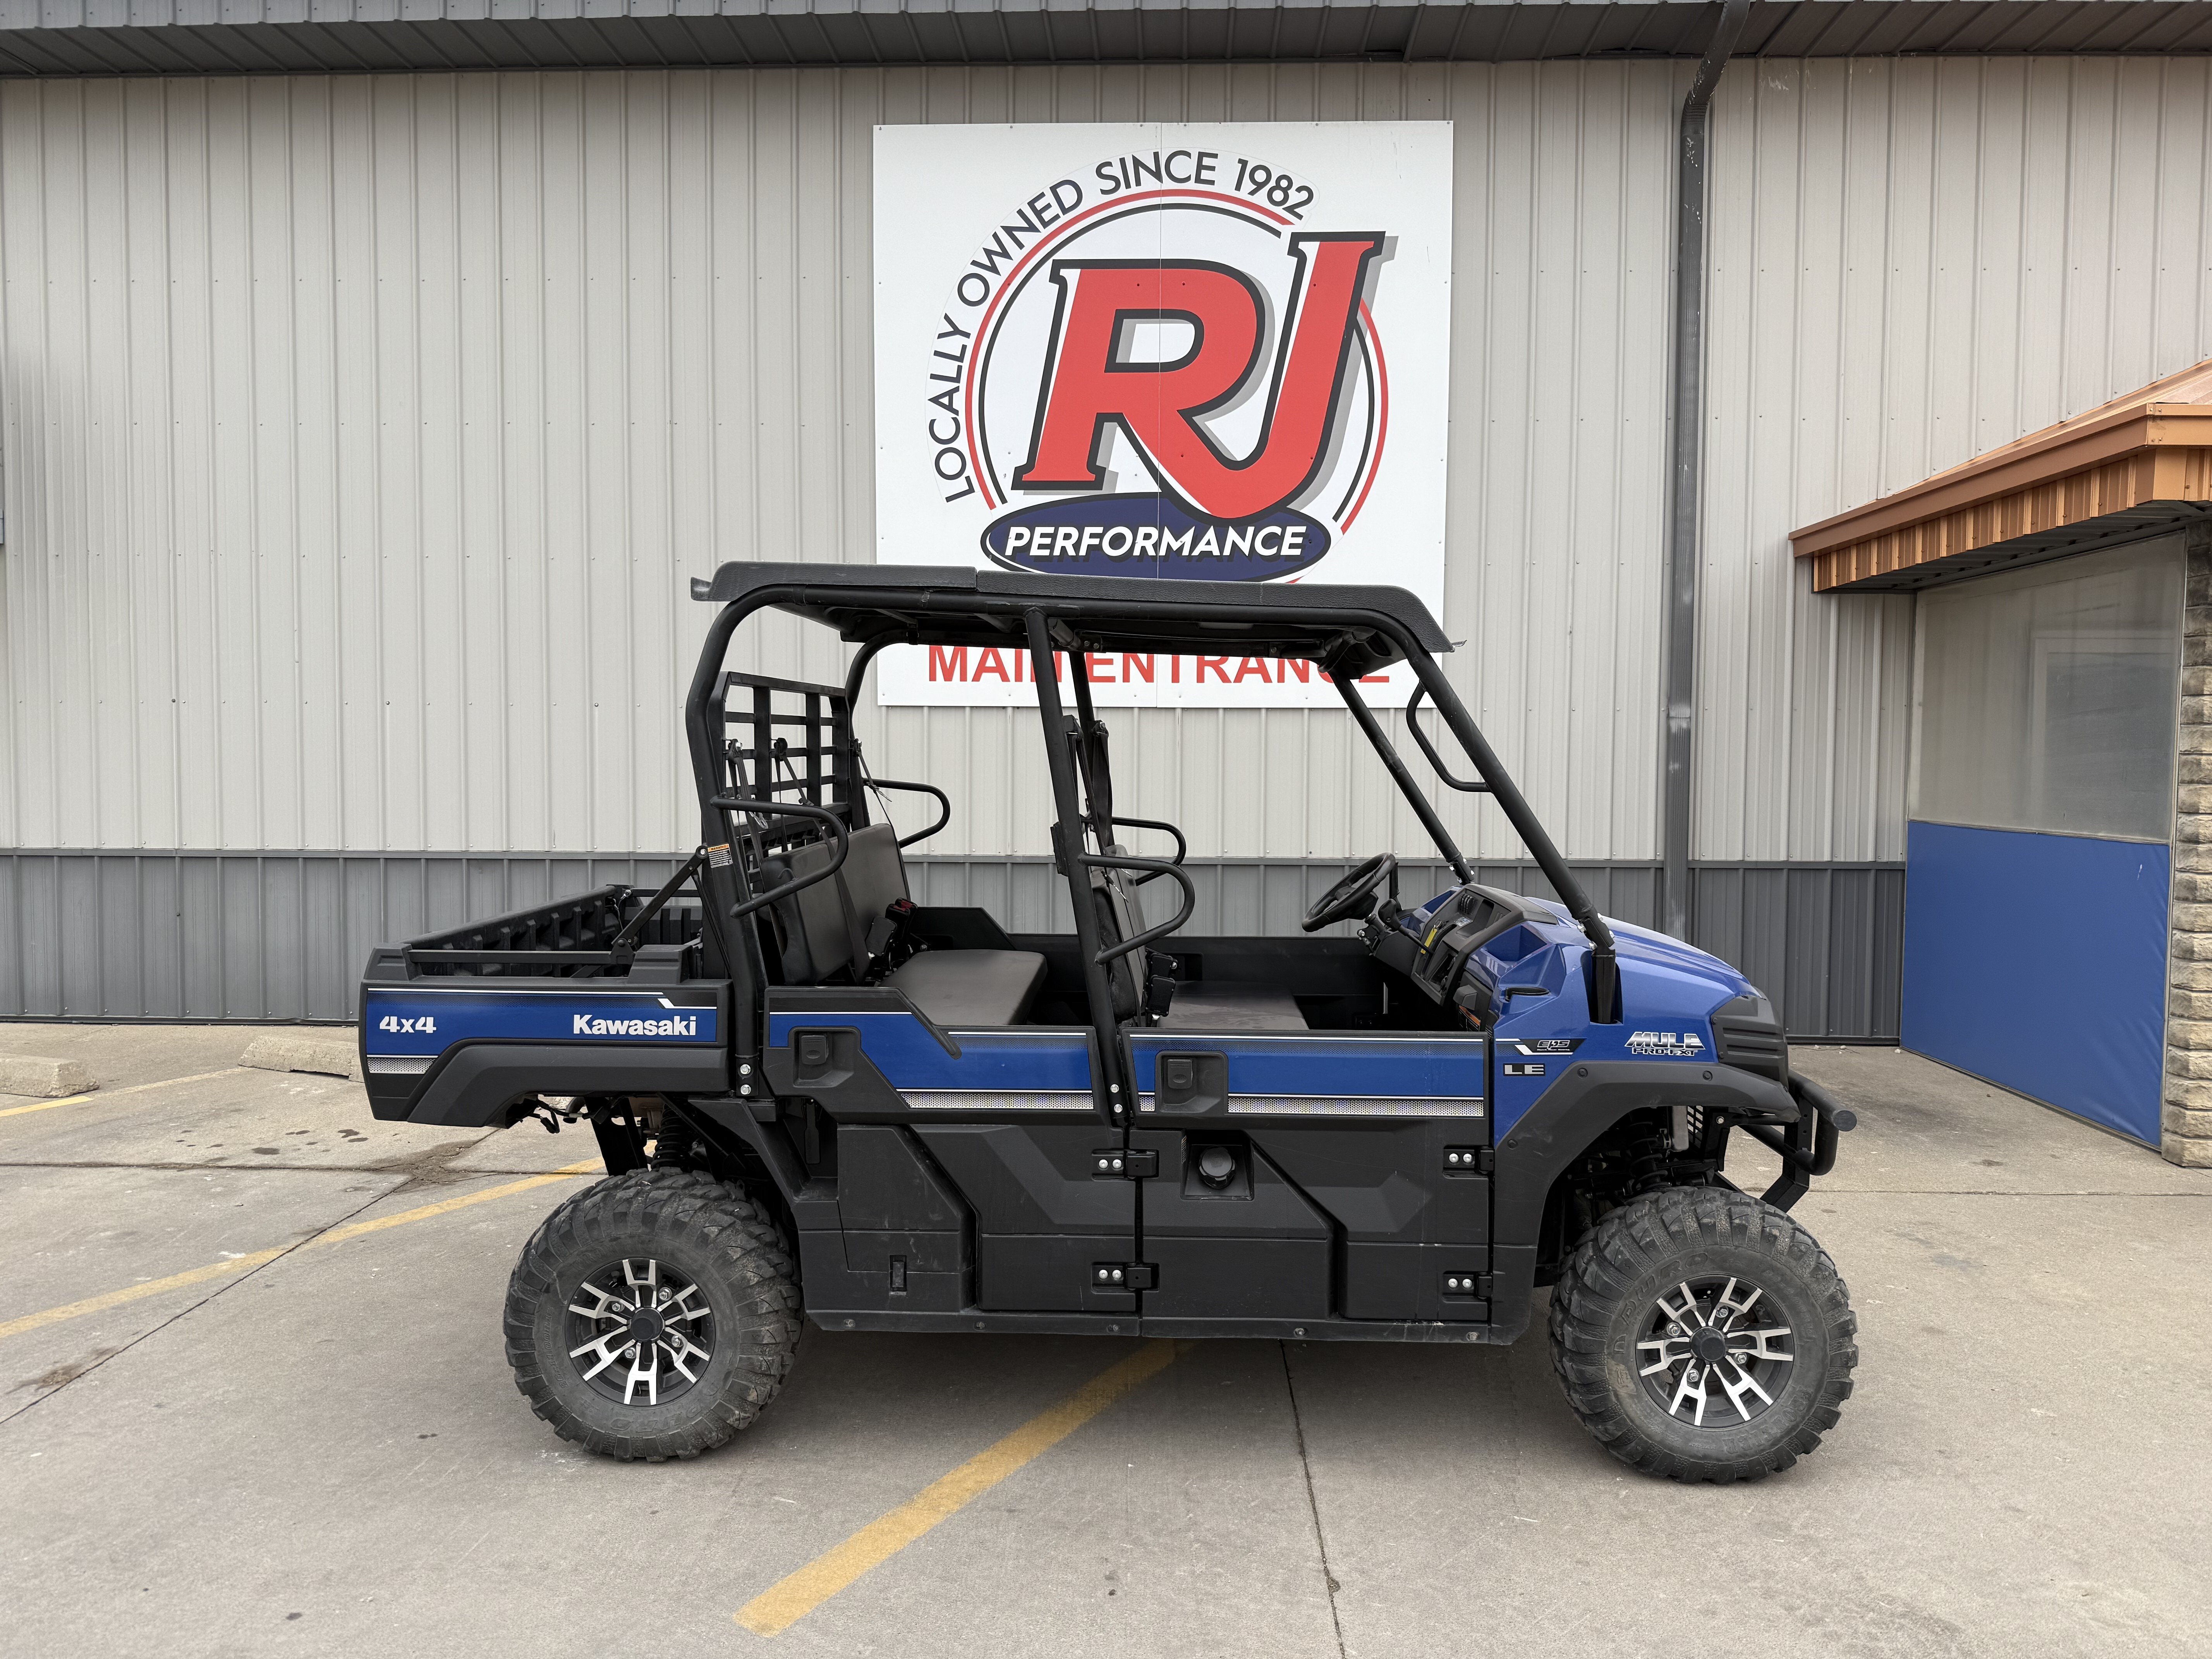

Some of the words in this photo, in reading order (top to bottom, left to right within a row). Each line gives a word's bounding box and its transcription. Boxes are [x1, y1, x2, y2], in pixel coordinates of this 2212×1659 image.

[927, 313, 975, 503] LOCALLY
[957, 179, 1083, 307] OWNED
[1096, 150, 1218, 195] SINCE
[1235, 158, 1314, 221] 1982
[1011, 231, 1386, 519] RJ
[1005, 525, 1307, 556] PERFORMANCE
[1085, 652, 1389, 683] ENRAN
[380, 1016, 436, 1033] 4x4
[573, 1014, 696, 1036] Kawasaki
[1537, 1040, 1570, 1049] EPS
[1625, 1031, 1705, 1050] MULE
[1632, 1047, 1698, 1056] PRO-FXT
[1504, 1065, 1544, 1074] LE
[1620, 1252, 1707, 1323] DURO
[610, 1400, 703, 1432] DURO
